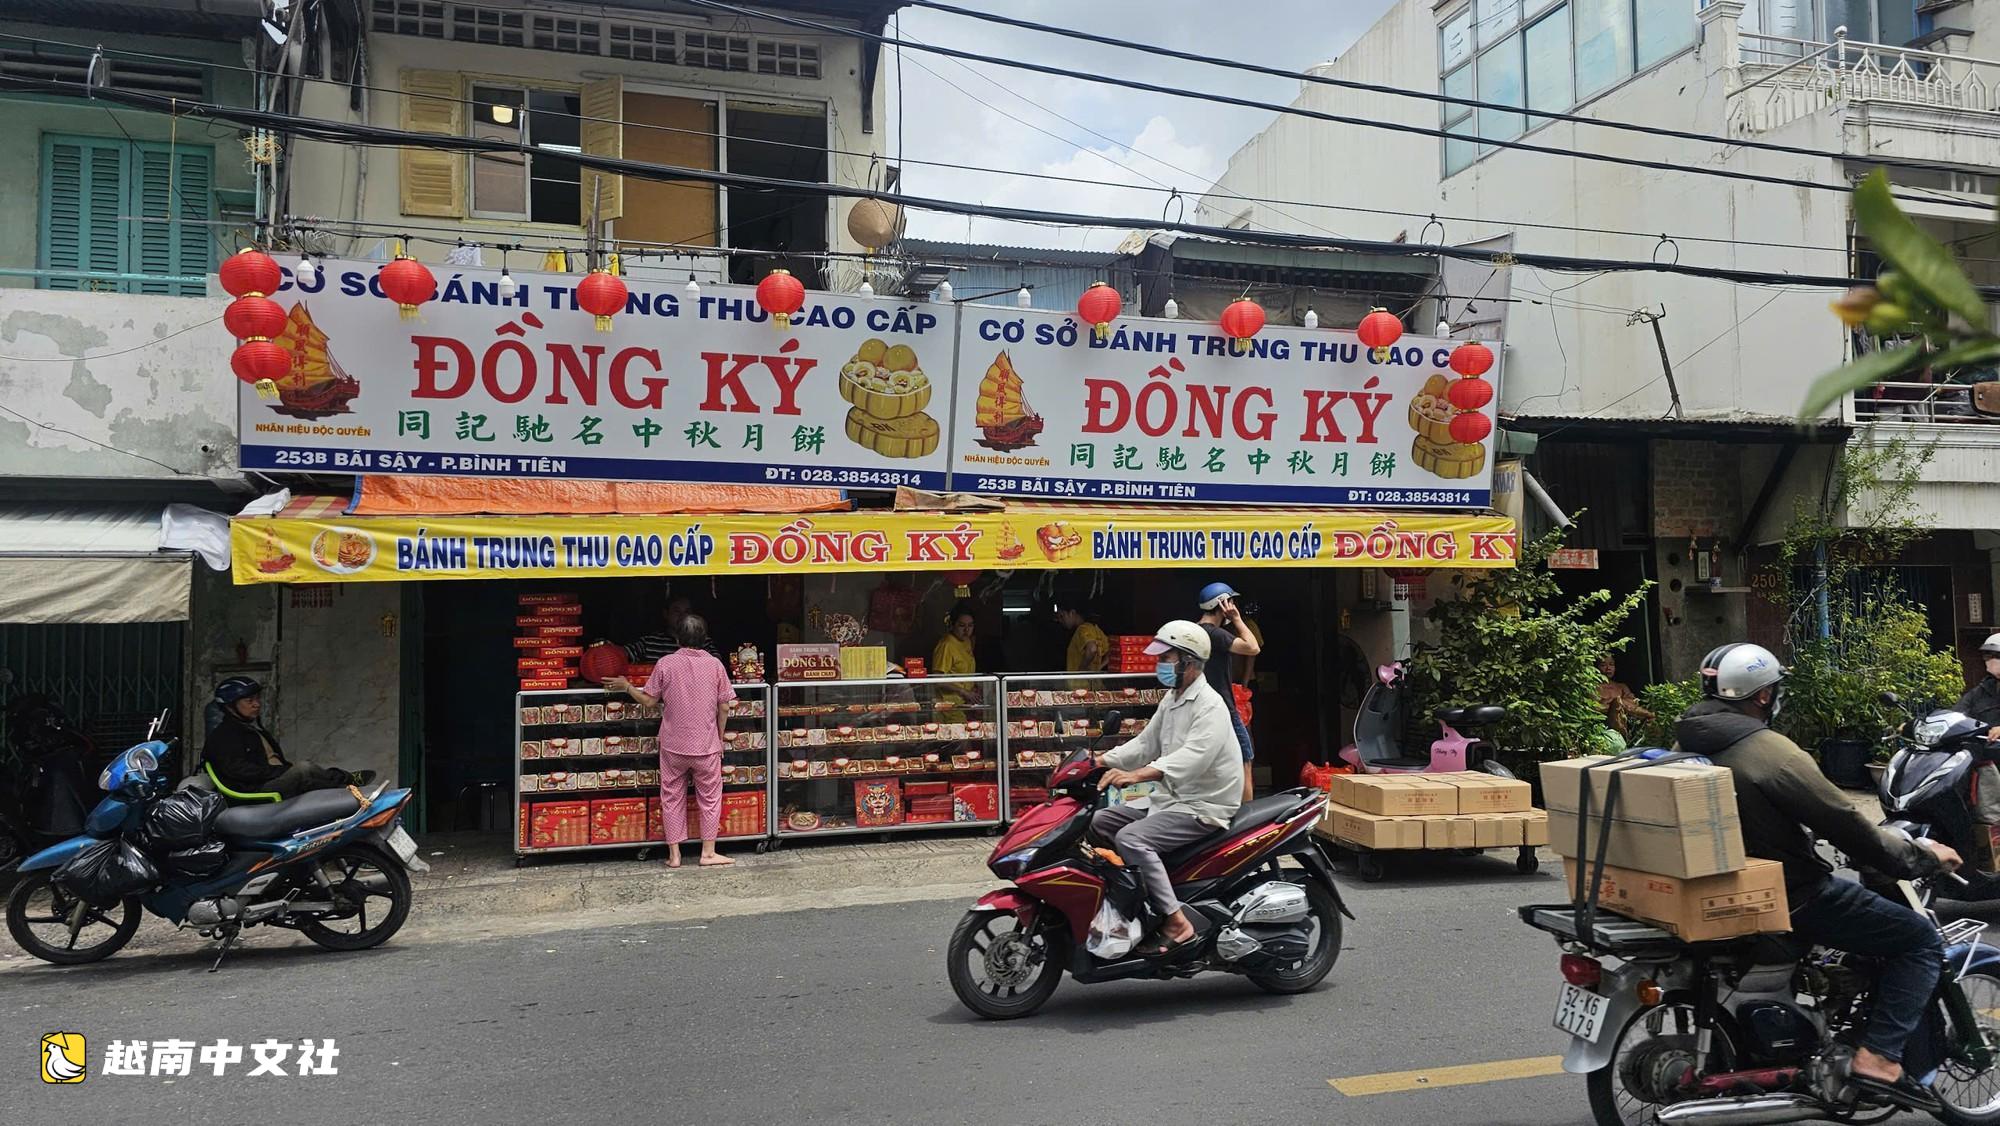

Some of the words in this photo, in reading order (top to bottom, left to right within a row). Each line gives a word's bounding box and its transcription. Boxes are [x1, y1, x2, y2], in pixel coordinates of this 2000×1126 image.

[429, 273, 529, 308] ÁNH
[543, 285, 680, 318] TNG
[866, 305, 937, 335] CẤP
[978, 318, 1025, 344] CƠ
[1034, 317, 1078, 347] SỞ
[1088, 324, 1177, 353] BÁNH
[1187, 334, 1290, 361] TRUNG
[1300, 341, 1358, 364] THU
[411, 312, 669, 410] ĐỒNG
[699, 338, 818, 416] KÝ
[1081, 356, 1278, 442] ĐỒNG
[1299, 375, 1393, 444] KÝ
[398, 409, 826, 456] 同記馳名中秋月餅
[275, 450, 328, 465] 253B
[334, 449, 371, 467] BÃI
[378, 452, 423, 472] SẬY
[441, 456, 511, 472] P.BÌNH
[517, 457, 567, 473] TIÊN
[765, 467, 796, 481] ĐT:
[800, 469, 922, 486] 028.38543814
[1069, 442, 1397, 479] 同記馳名中秋月餅
[977, 478, 1017, 491] 253B
[1021, 477, 1049, 492] BÃI
[1054, 479, 1088, 496] SẬY
[1100, 481, 1154, 496] P.BÌNH
[1158, 482, 1196, 498] TIÊN
[1348, 489, 1372, 501] ĐT:
[1375, 490, 1471, 503] 028.38543814
[396, 528, 466, 570] BÁNH
[473, 536, 555, 569] TRUNG
[562, 536, 609, 567] THU
[616, 534, 663, 567] CAO
[668, 523, 714, 566] CẤP
[729, 518, 891, 566] ĐỒNG
[904, 521, 983, 562] KÝ
[1093, 523, 1142, 559] BÁNH
[1147, 531, 1206, 559] TRUNG
[1210, 531, 1245, 559] THU
[1249, 531, 1284, 559] CAO
[1288, 523, 1322, 559] CẤP
[1333, 520, 1457, 560] ĐỒNG
[1559, 1007, 1594, 1038] 2179
